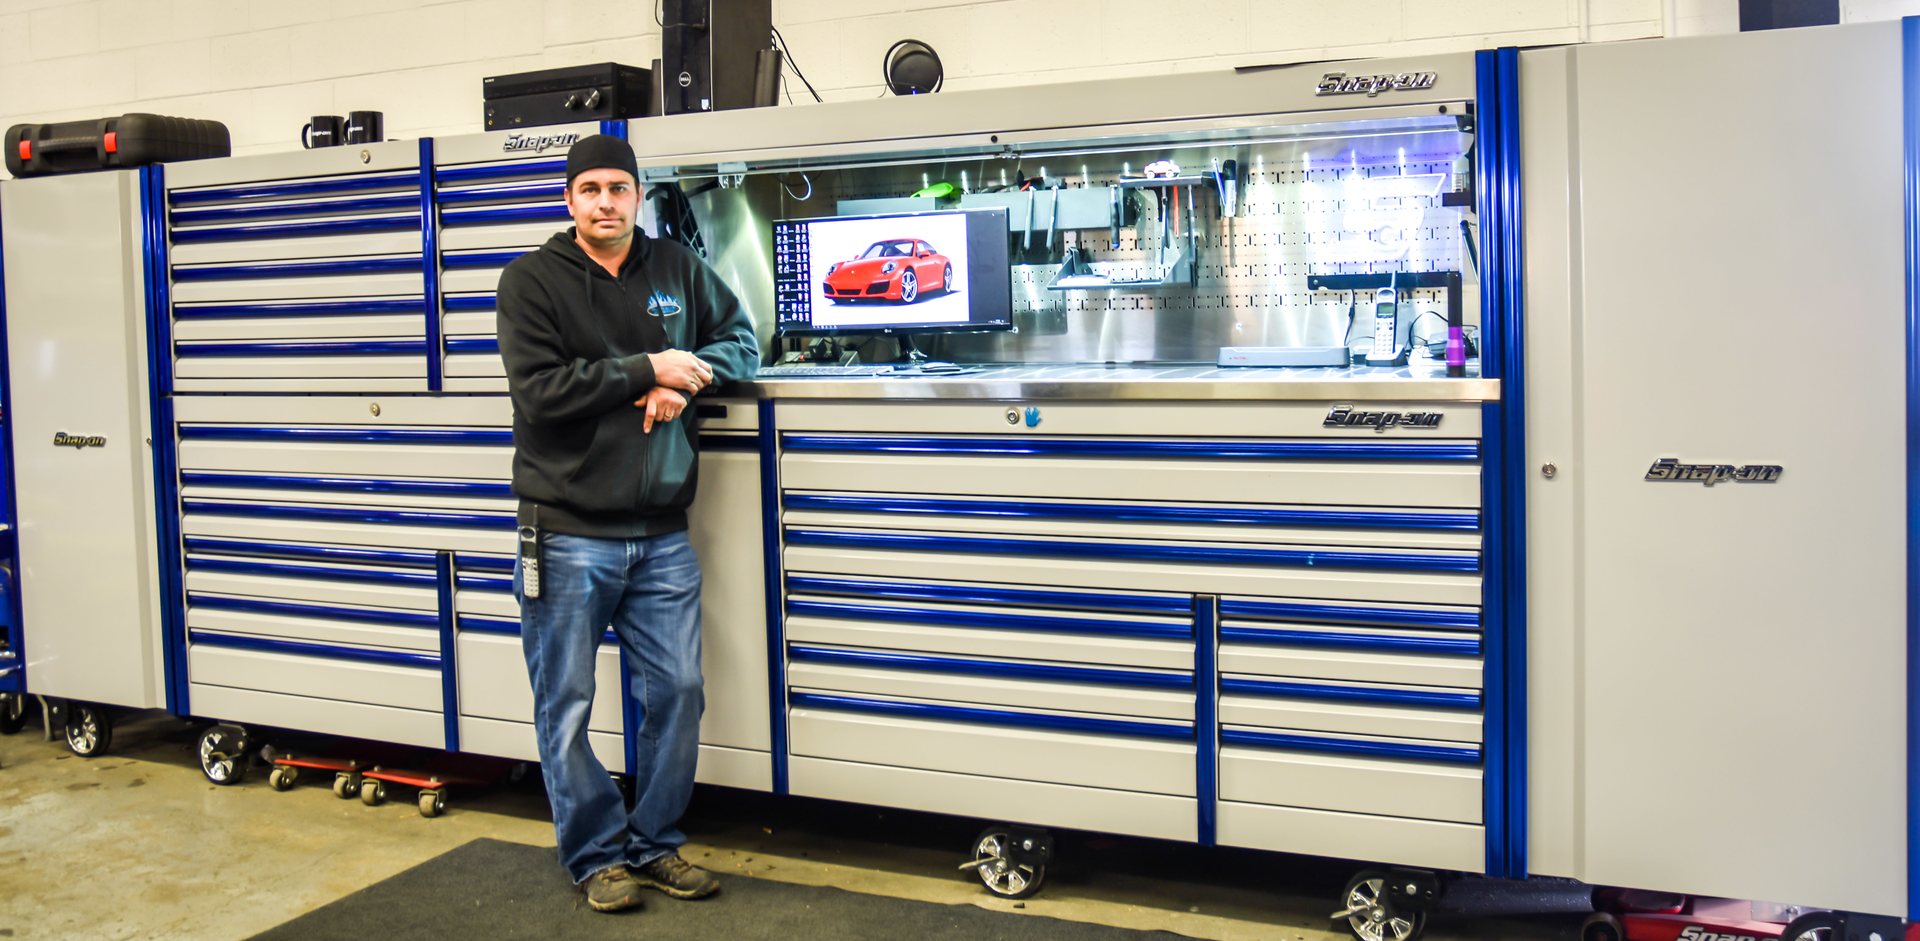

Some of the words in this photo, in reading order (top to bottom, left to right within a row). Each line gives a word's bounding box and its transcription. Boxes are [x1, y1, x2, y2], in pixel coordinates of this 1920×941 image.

[1316, 71, 1437, 97] Snap-on
[503, 133, 580, 153] Snap-on
[1323, 405, 1444, 433] Snap-on
[54, 431, 106, 450] Snap-on
[1644, 458, 1784, 487] Snap-on
